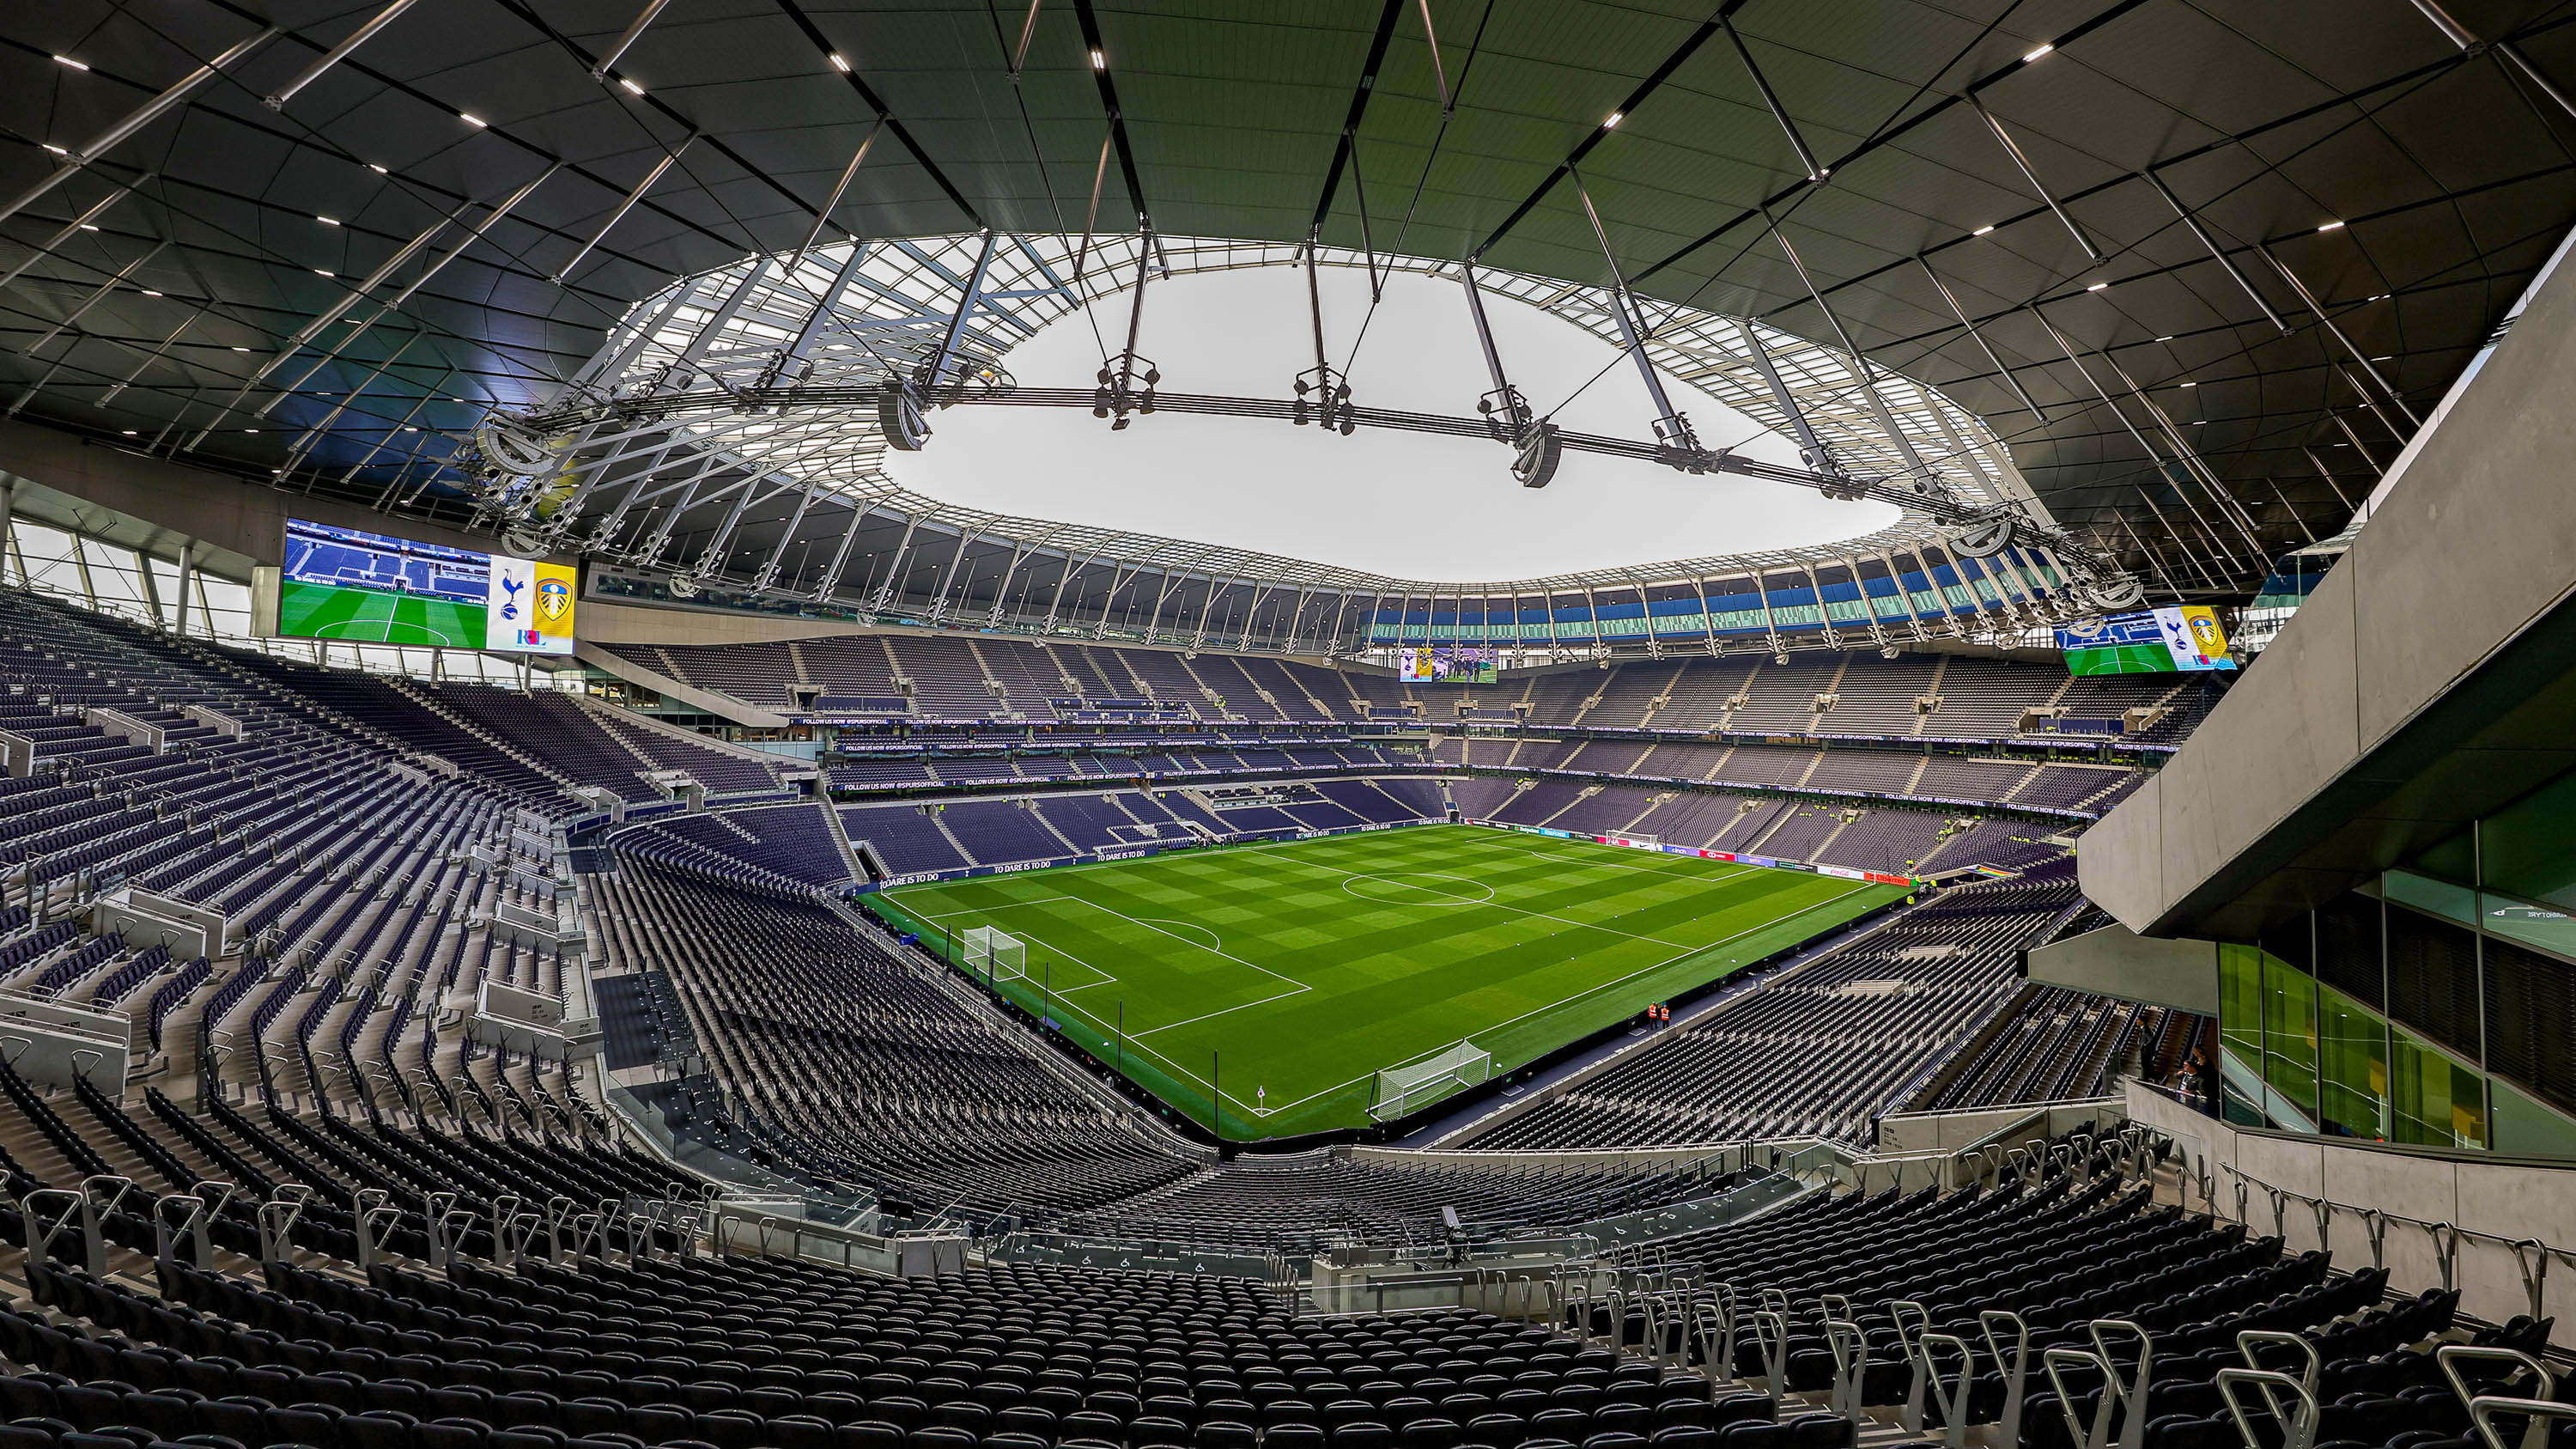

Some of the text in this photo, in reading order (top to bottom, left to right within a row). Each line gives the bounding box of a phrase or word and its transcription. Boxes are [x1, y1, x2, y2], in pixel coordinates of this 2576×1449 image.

[1820, 788, 1866, 797] @SPURSOFFICIAL
[1934, 797, 1985, 807] @SPURSOFFICIAL
[1005, 864, 1022, 873] DARE
[886, 876, 906, 887] DARE
[915, 874, 926, 883] TO
